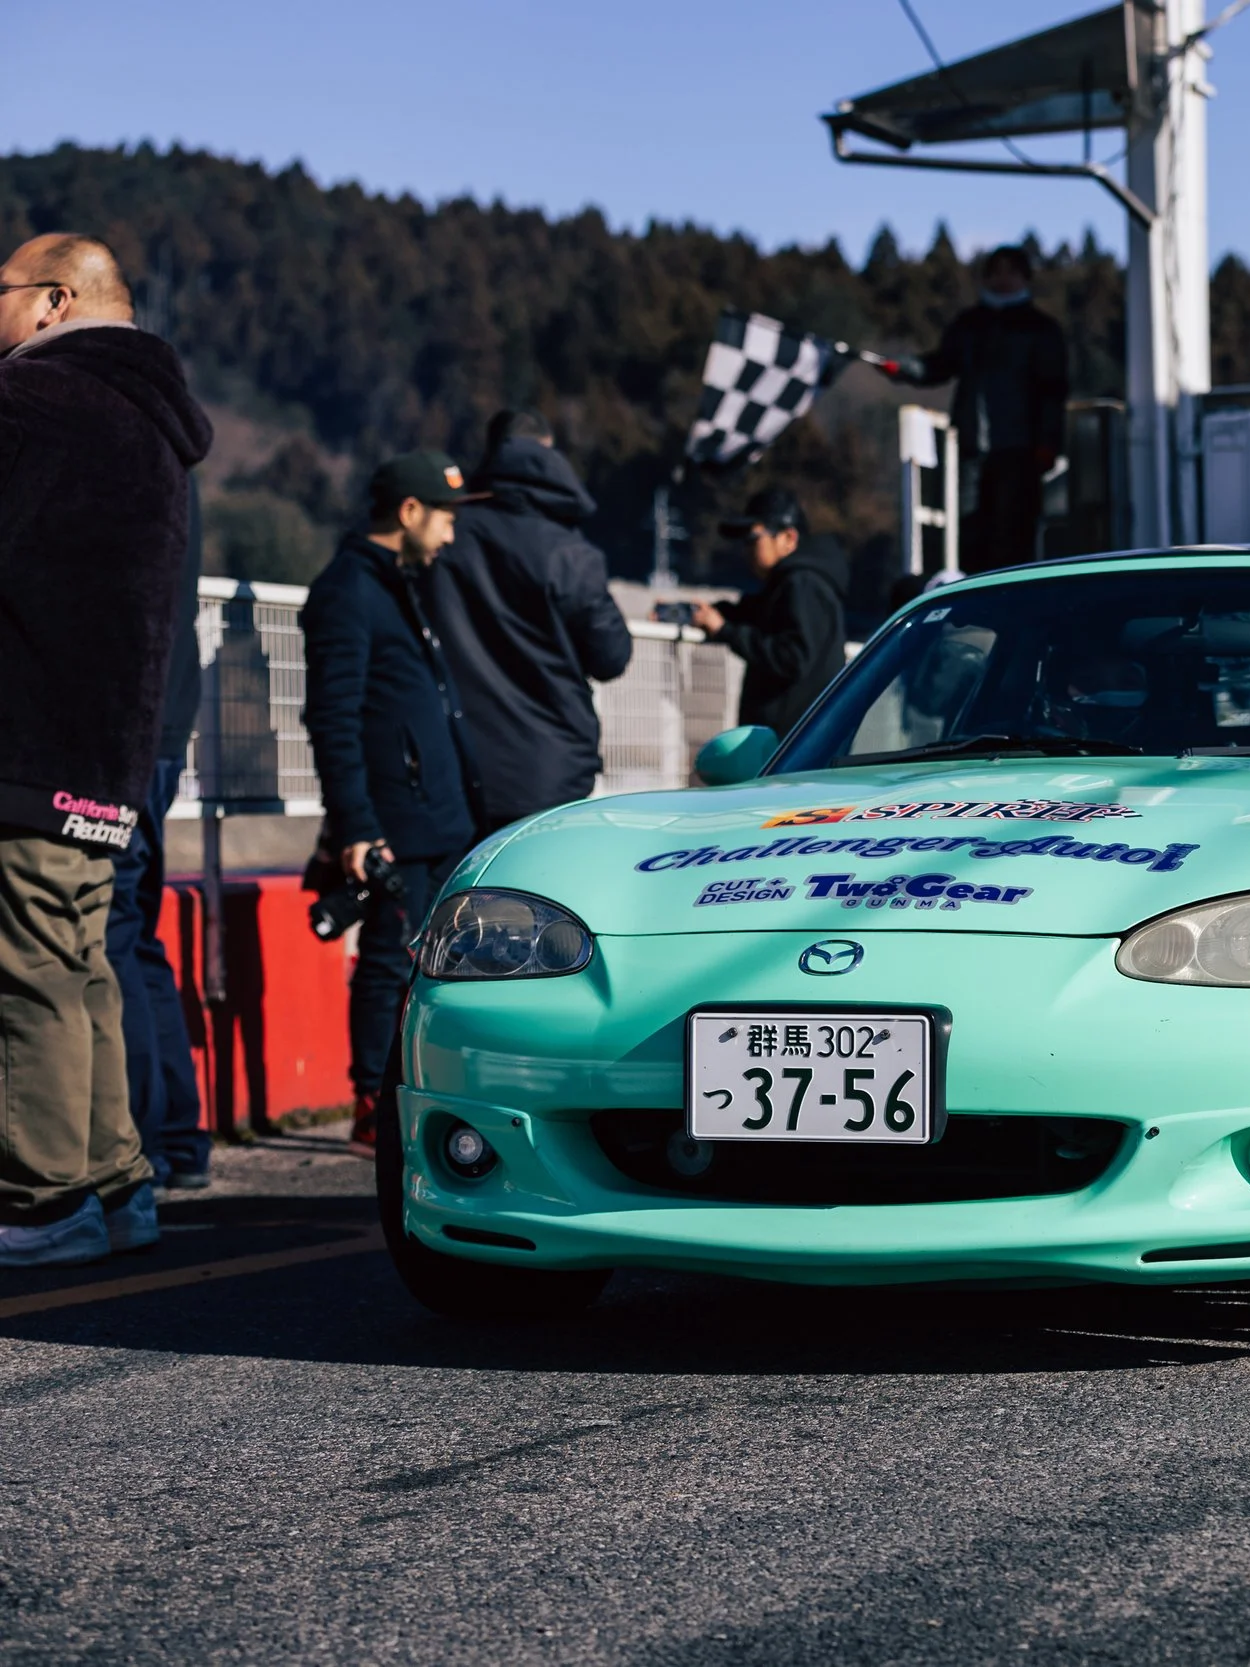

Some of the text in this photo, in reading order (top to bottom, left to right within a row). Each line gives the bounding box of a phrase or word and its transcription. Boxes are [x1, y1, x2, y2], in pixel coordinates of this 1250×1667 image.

[845, 801, 1127, 823] SPIRIT
[707, 879, 762, 893] CUT
[697, 887, 791, 904] DESIGN
[846, 899, 957, 909] GUNMA
[702, 1066, 917, 1133] つ 37-56
